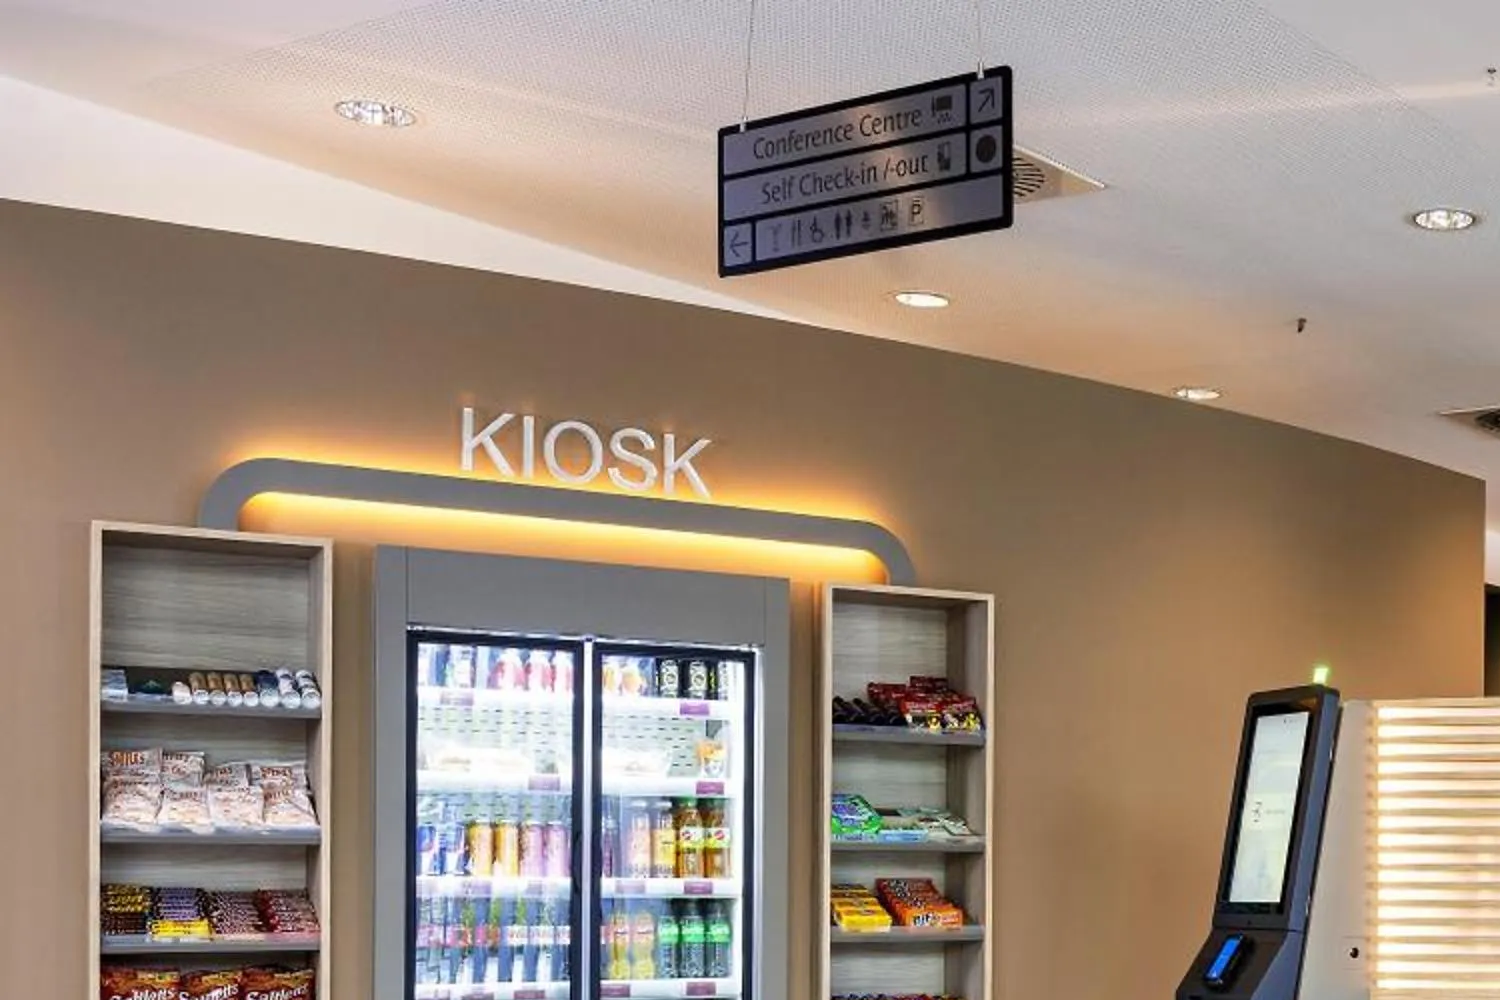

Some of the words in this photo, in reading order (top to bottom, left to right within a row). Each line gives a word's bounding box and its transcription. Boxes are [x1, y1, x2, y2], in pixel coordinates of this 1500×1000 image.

[753, 122, 855, 160] Conference
[859, 107, 922, 137] Centre
[761, 176, 795, 205] Self
[799, 165, 877, 199] Check-in
[461, 407, 712, 500] KIOSK
